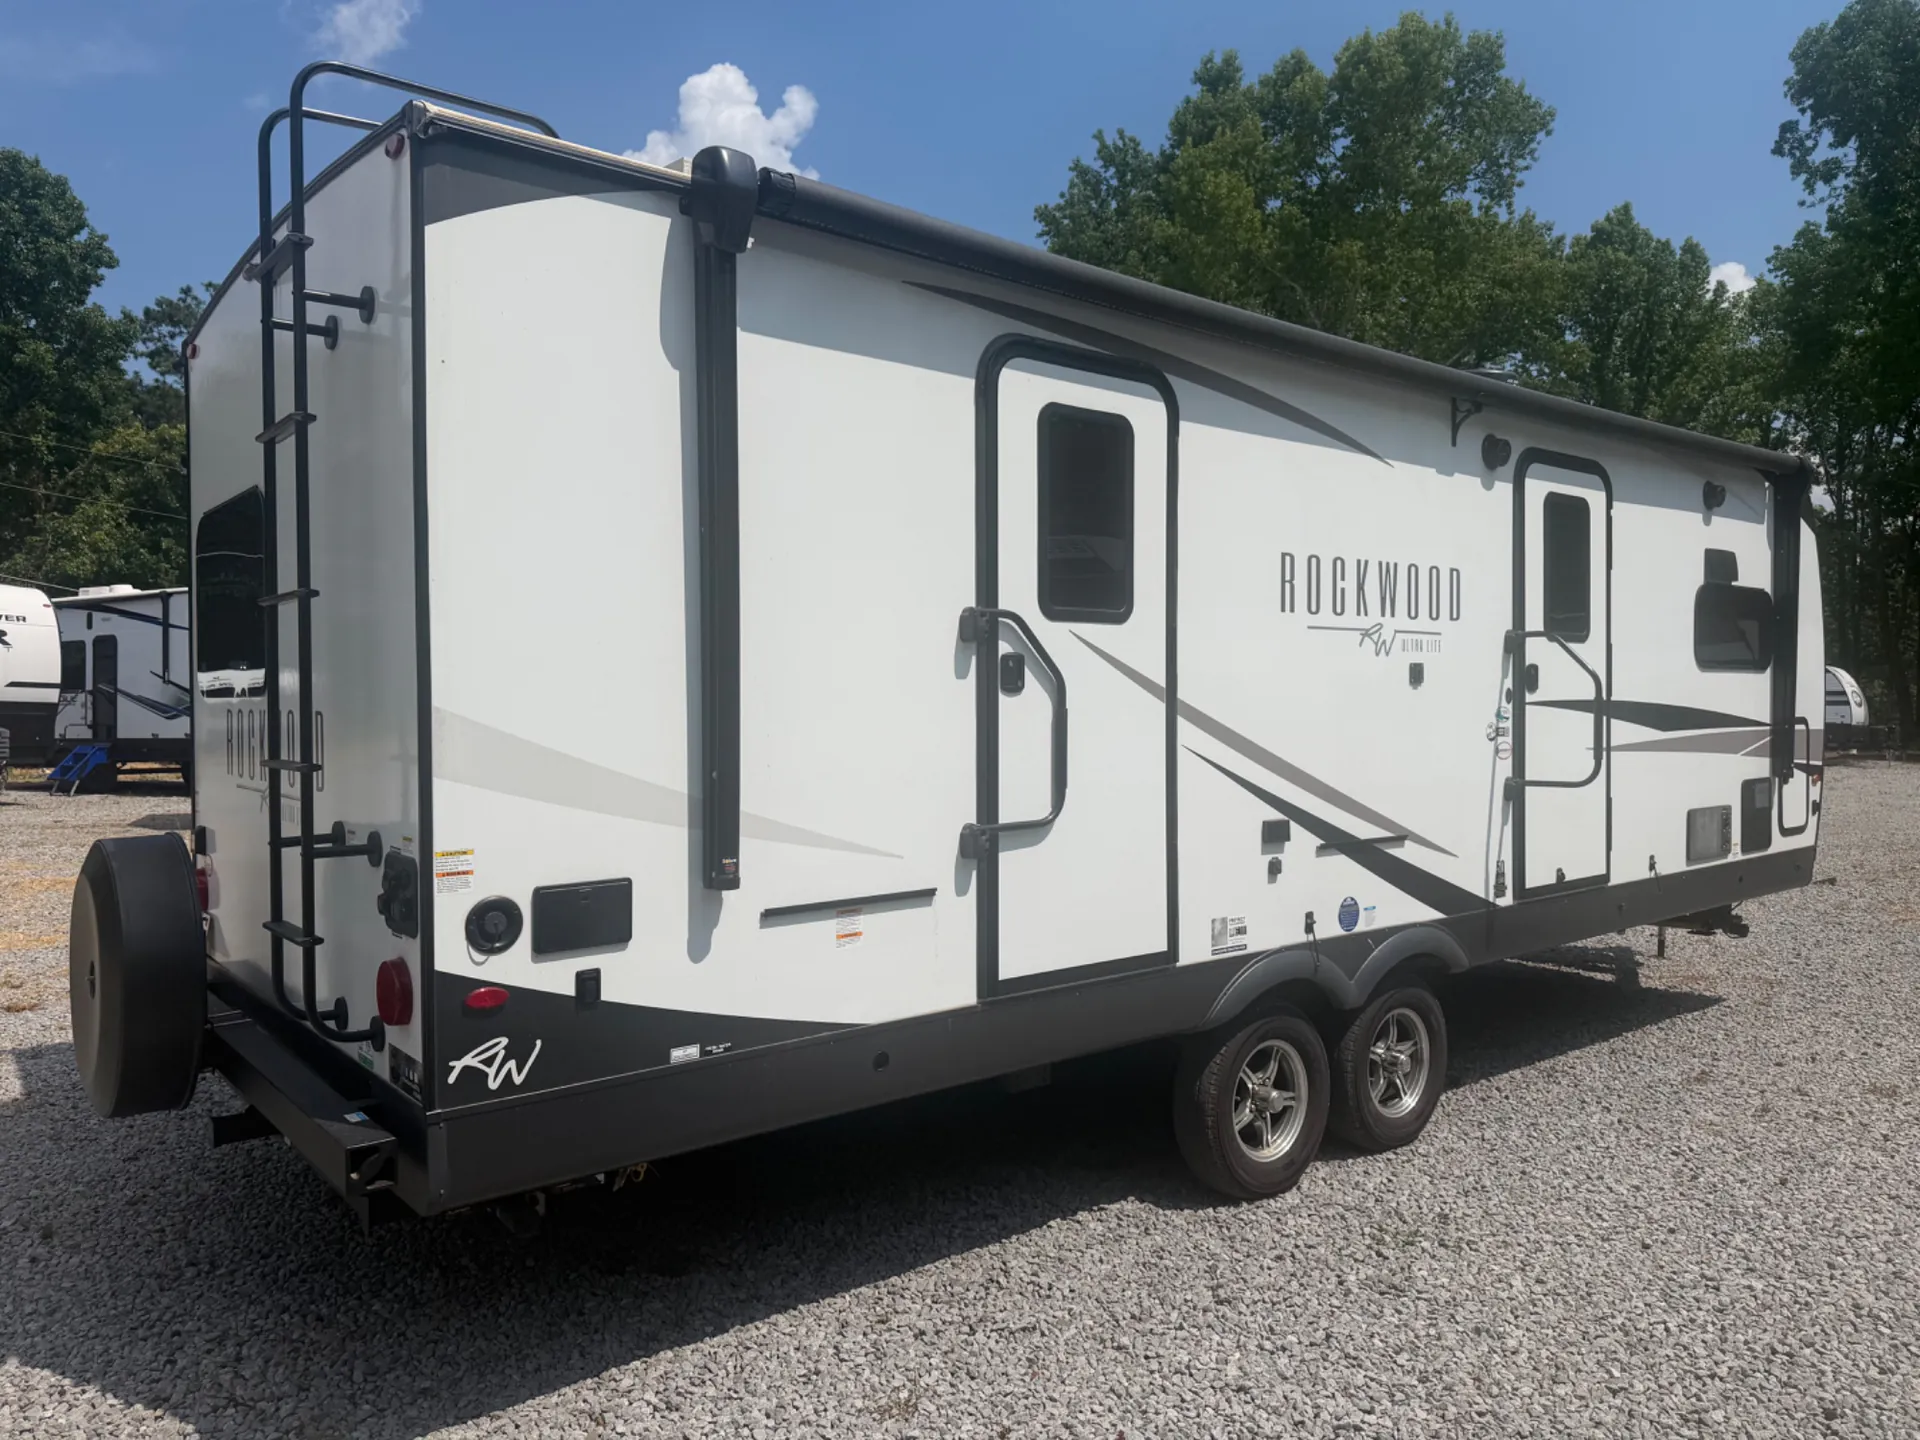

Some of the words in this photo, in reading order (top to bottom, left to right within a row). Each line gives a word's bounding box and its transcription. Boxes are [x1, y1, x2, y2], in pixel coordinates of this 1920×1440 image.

[1280, 551, 1461, 621] ROCKWOOD
[226, 708, 325, 792] ROCKOD
[447, 1036, 542, 1090] RW
